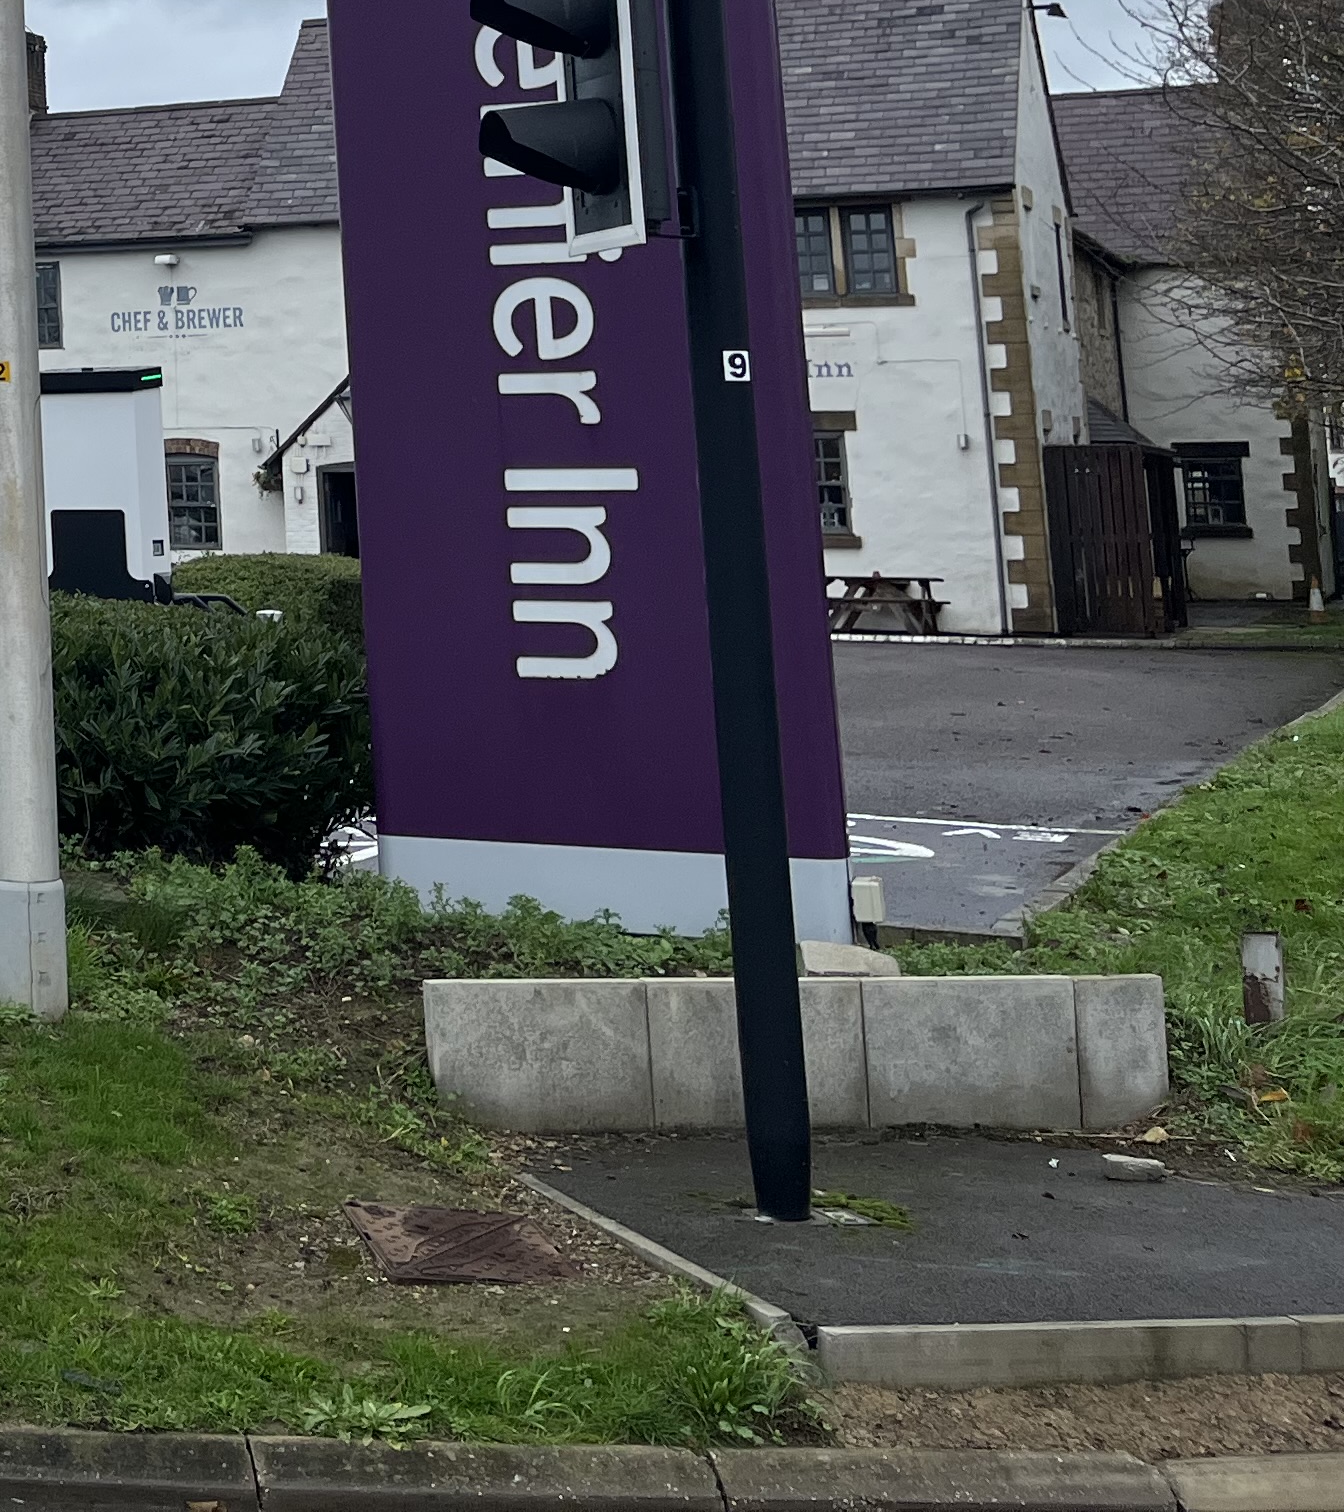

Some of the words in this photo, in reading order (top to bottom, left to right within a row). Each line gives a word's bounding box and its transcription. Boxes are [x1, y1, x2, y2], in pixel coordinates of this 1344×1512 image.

[110, 311, 152, 333] CHEF
[157, 309, 169, 331] &
[175, 307, 244, 330] BREWER
[728, 353, 747, 378] 9
[503, 467, 640, 680] Inn
